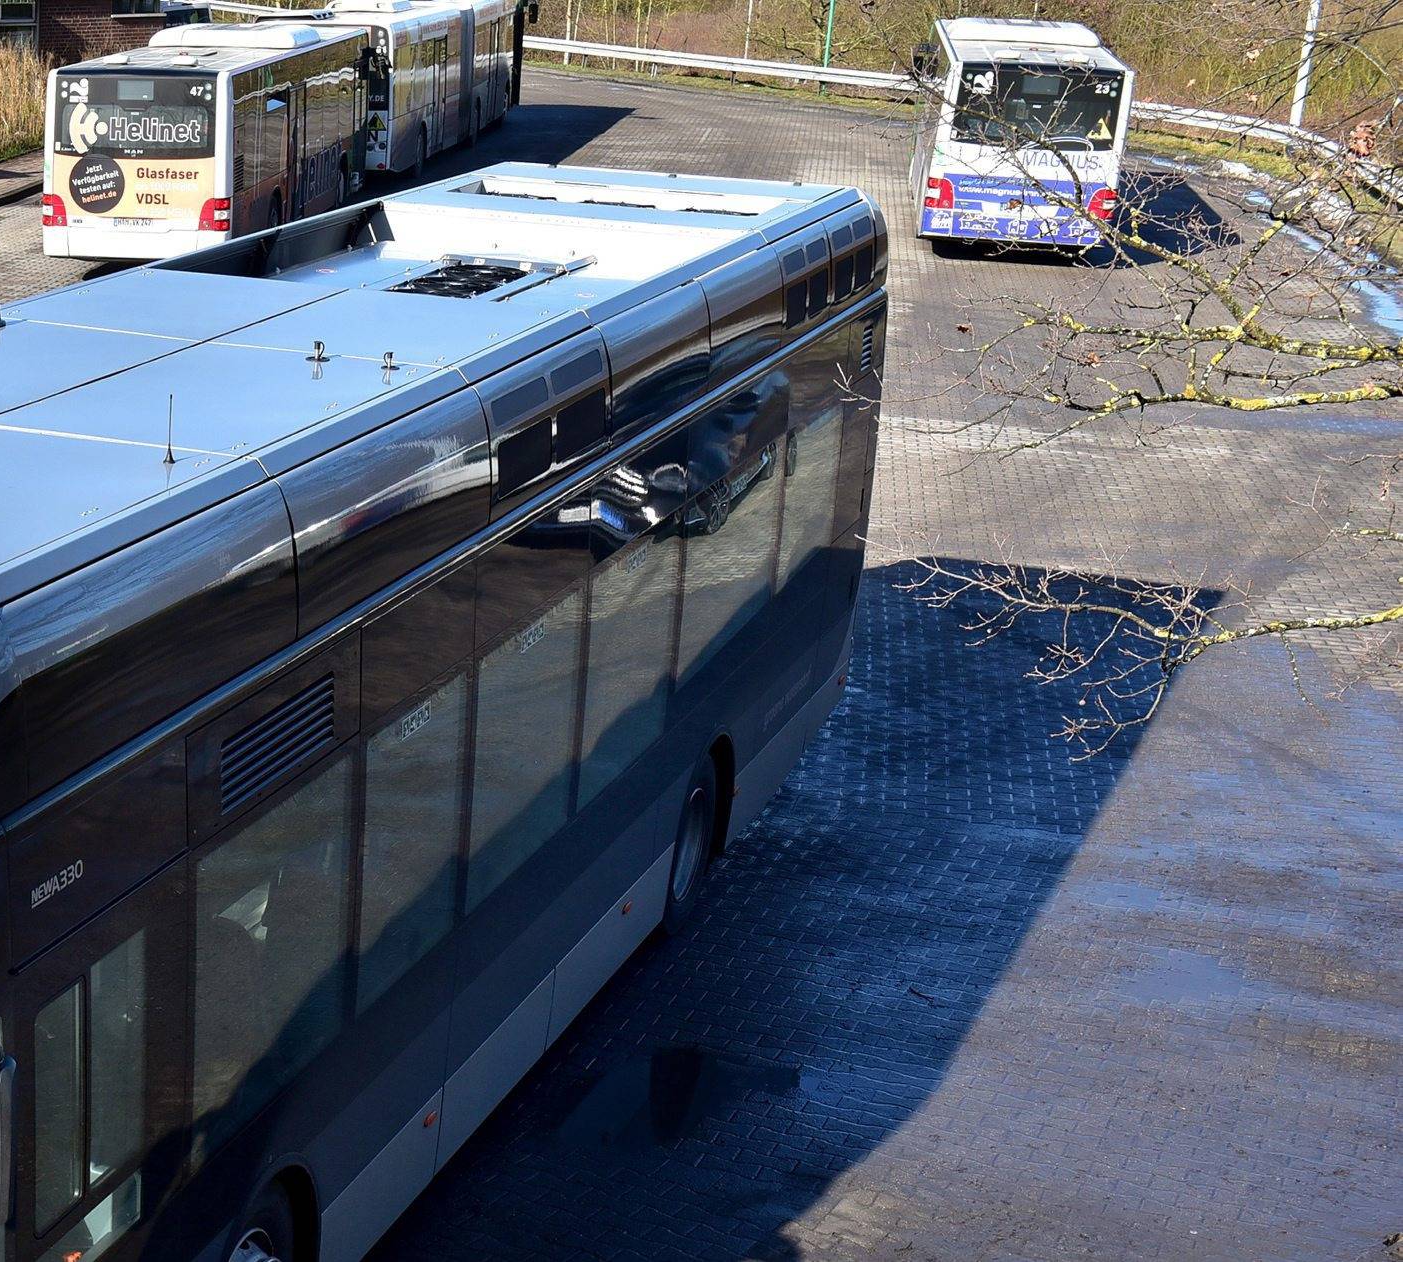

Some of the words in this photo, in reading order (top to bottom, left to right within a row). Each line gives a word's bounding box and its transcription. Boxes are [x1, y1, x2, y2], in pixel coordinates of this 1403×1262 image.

[189, 86, 204, 97] 47
[1095, 84, 1110, 94] 23
[109, 116, 201, 143] Helinet
[85, 164, 103, 174] Jetzt
[136, 167, 200, 180] Glasfaser
[71, 170, 119, 186] Verfügbarkeit
[79, 184, 101, 195] testen
[81, 191, 117, 203] helinet.de
[136, 193, 170, 205] VDSL
